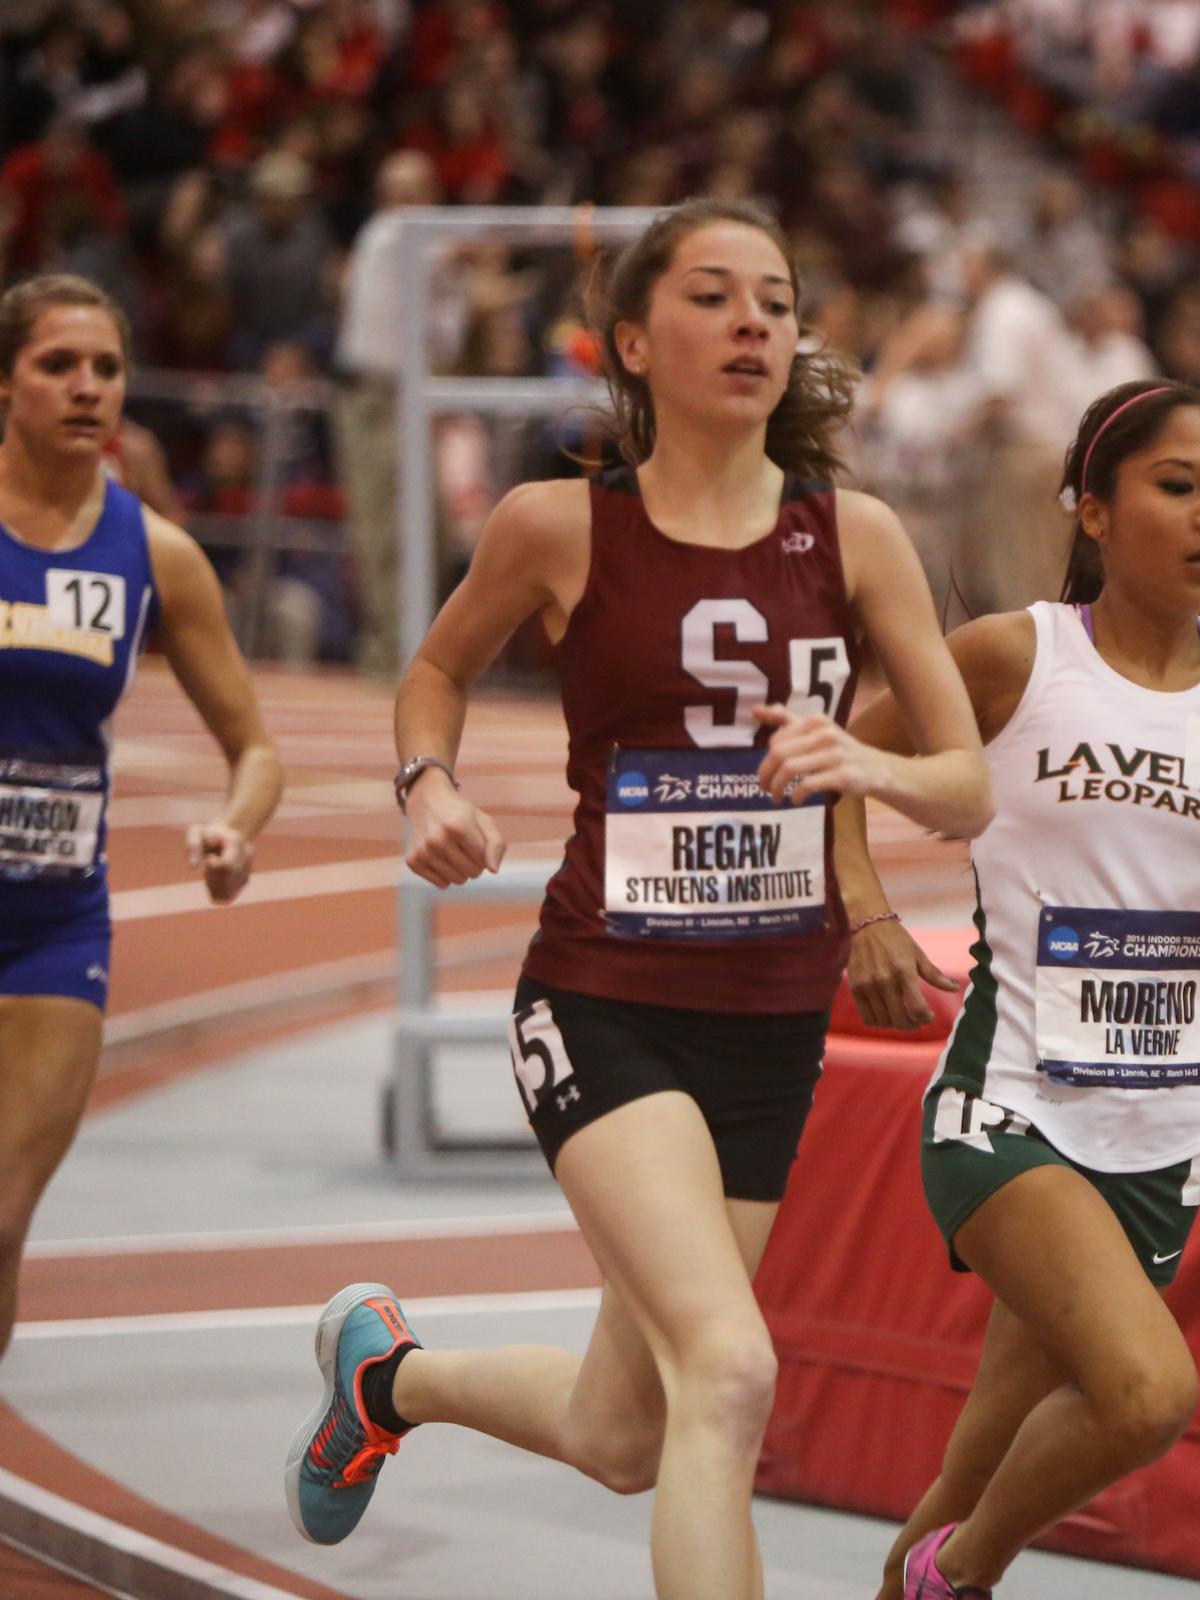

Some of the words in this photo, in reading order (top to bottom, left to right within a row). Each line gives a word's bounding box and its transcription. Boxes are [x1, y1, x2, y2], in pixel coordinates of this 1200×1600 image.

[64, 578, 113, 632] 12
[681, 598, 769, 748] S
[808, 646, 838, 718] 5
[618, 786, 649, 798] NCAA
[672, 823, 782, 872] REGAN
[626, 875, 720, 904] STEVENS
[727, 869, 813, 903] INSTITUTE
[1050, 940, 1080, 951] NCAA
[1126, 934, 1145, 944] 2014
[1147, 935, 1181, 945] INDOOR
[1080, 979, 1198, 1026] MORENO
[514, 1004, 556, 1105] 5
[1105, 1028, 1125, 1055] LA
[1131, 1029, 1181, 1056] VERNE
[1073, 1066, 1106, 1078] Division
[1150, 1069, 1161, 1078] NE
